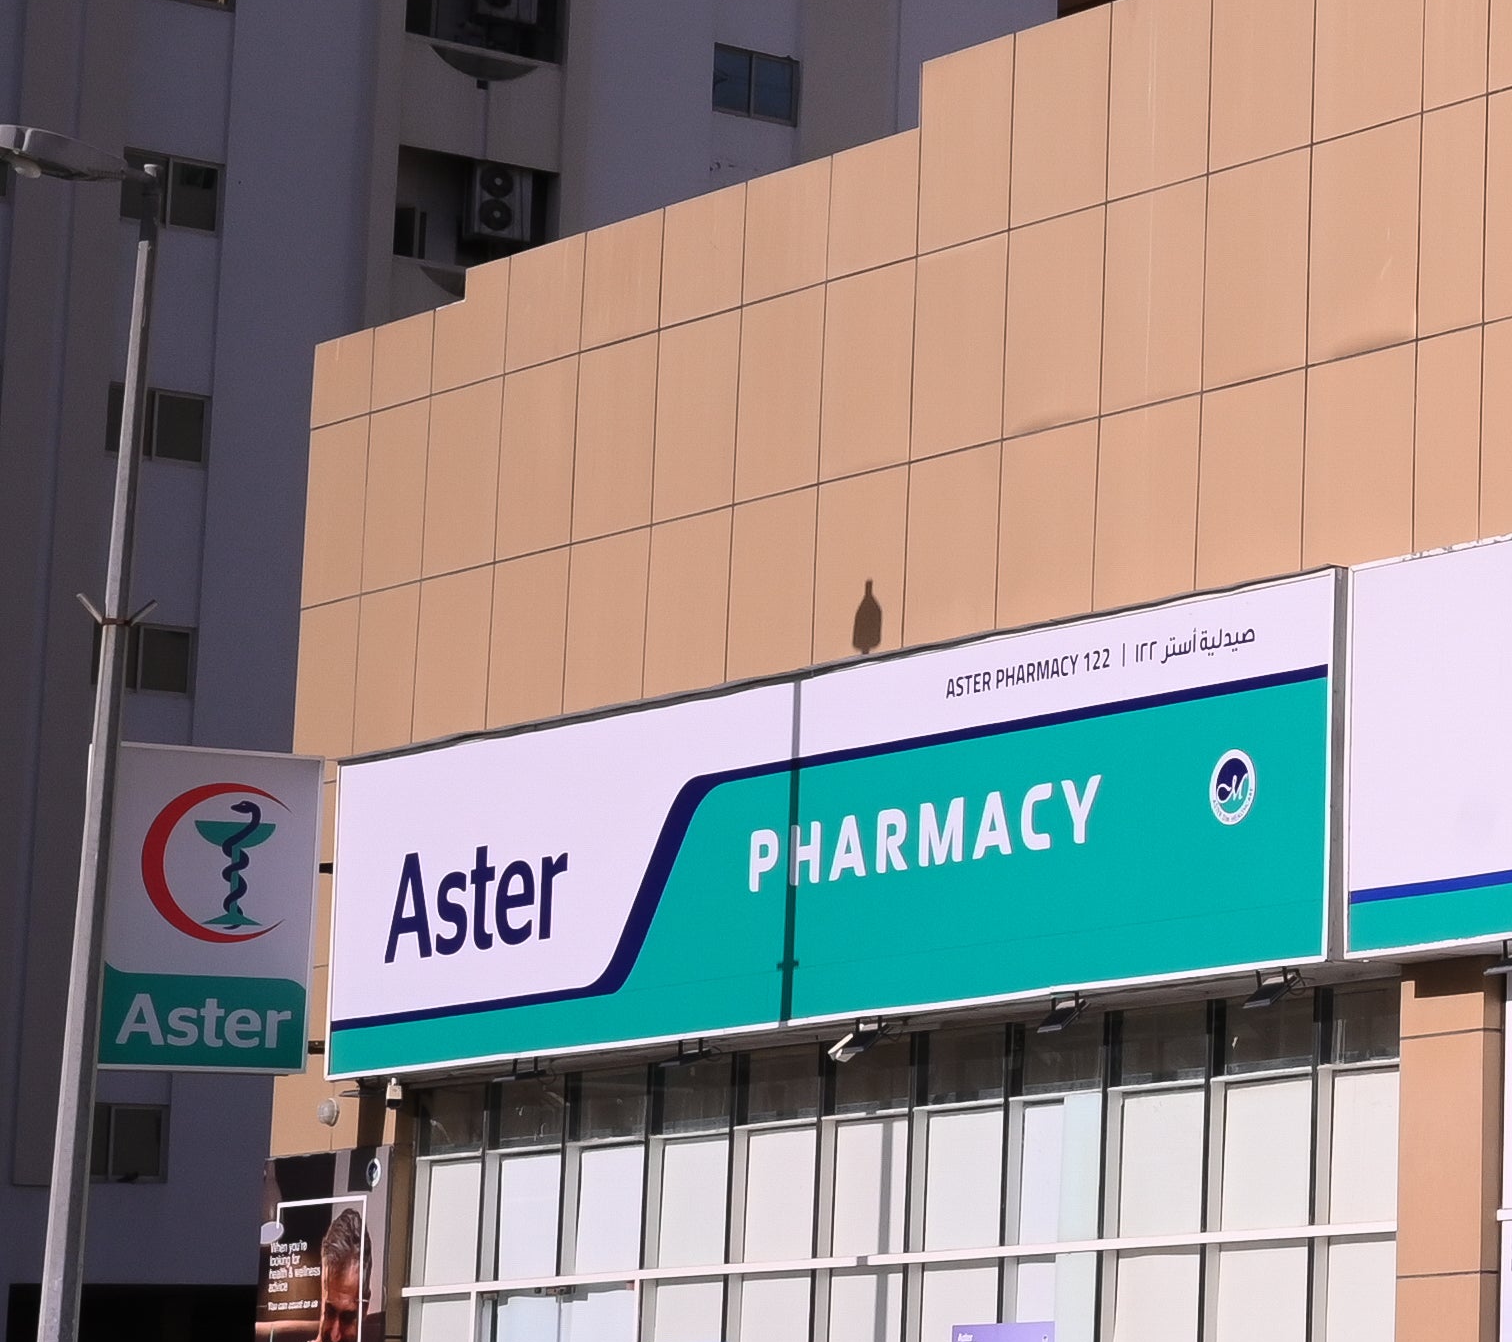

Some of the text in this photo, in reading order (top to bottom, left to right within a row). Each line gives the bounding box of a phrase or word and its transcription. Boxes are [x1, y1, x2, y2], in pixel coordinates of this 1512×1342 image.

[1160, 628, 1197, 664] أستر
[1199, 627, 1256, 656] صيدلية
[946, 648, 1111, 699] ASTER PHARMACY 122
[748, 774, 1102, 893] PHARMACY
[384, 844, 568, 965] Aster
[115, 992, 293, 1049] Aster
